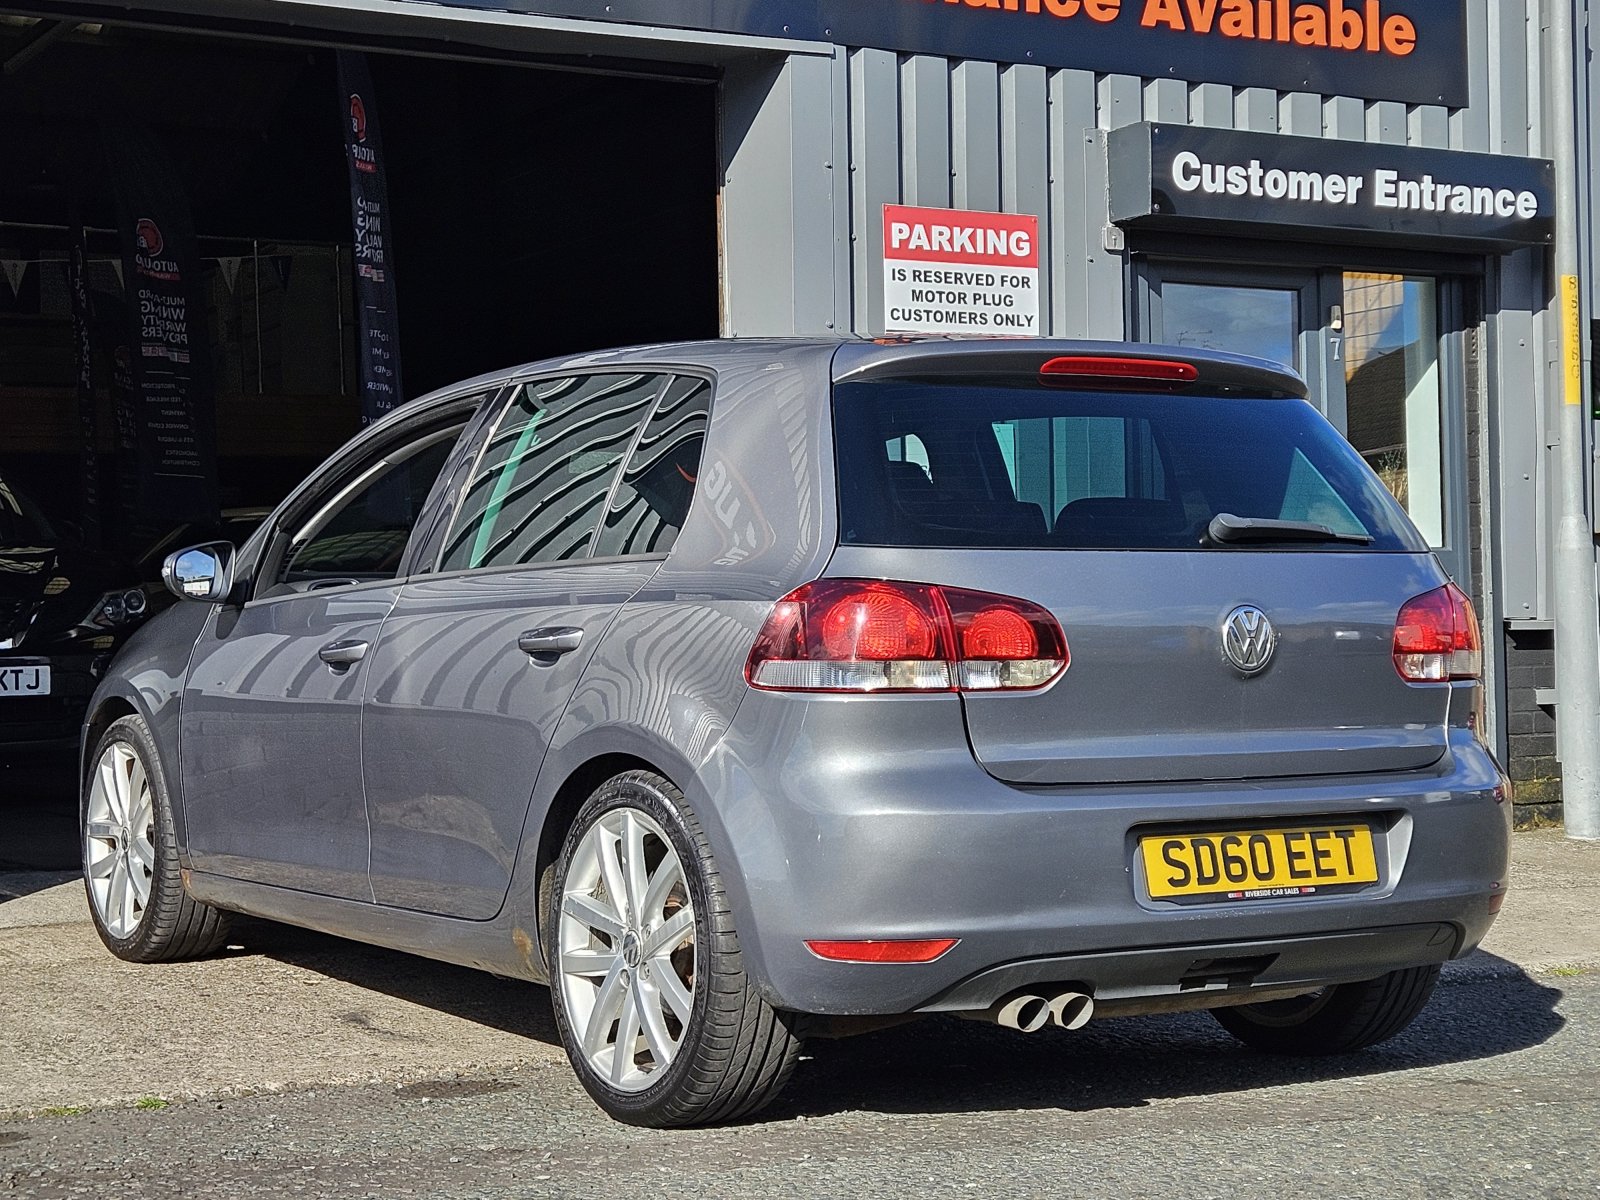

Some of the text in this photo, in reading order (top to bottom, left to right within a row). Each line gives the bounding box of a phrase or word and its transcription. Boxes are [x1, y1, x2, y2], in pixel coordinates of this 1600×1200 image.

[1172, 151, 1538, 219] Customer Entrance
[891, 222, 1031, 257] PARKING
[891, 268, 1031, 289] IS RESERVED FOR
[911, 289, 1014, 307] MOTOR PLUG
[890, 308, 1034, 328] CUSTOMERS ONLY
[1330, 337, 1341, 361] 7
[1162, 829, 1356, 888] SD60 EET
[1245, 889, 1271, 898] RIVERSIDE
[1272, 888, 1284, 896] CAR
[1284, 887, 1300, 895] SALES
